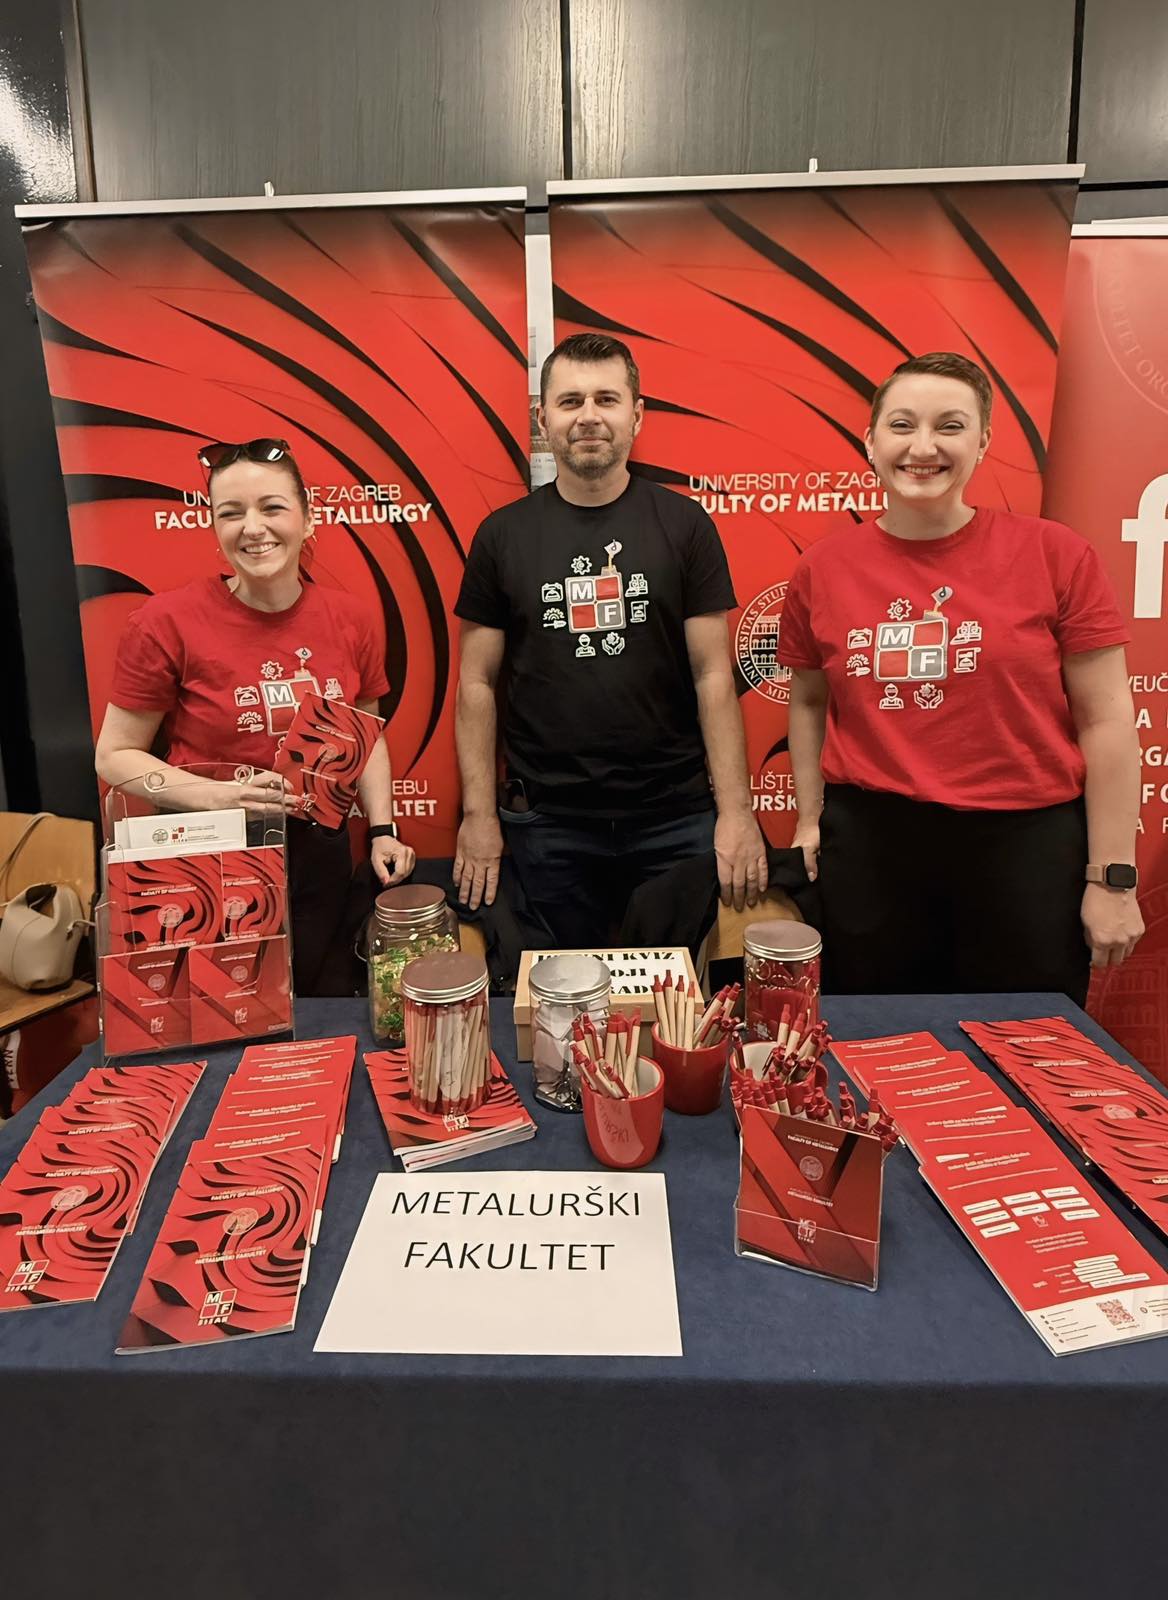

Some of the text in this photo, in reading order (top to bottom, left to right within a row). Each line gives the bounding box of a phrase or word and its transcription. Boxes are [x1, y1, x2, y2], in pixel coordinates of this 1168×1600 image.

[689, 472, 800, 492] UNIVERSITY
[805, 471, 831, 490] OF
[325, 484, 402, 503] ZAGREB
[689, 493, 756, 514] ULTY
[759, 492, 791, 513] OF
[154, 503, 432, 530] FACU ETALLURGY
[571, 582, 593, 602] M
[604, 604, 617, 624] F
[881, 627, 910, 646] M
[919, 651, 938, 673] F
[267, 685, 291, 704] M
[623, 952, 675, 962] KVIZ
[610, 968, 647, 978] OJI
[610, 984, 655, 995] AD
[391, 1185, 640, 1216] METALURŠKI
[404, 1241, 615, 1270] FAKULTET
